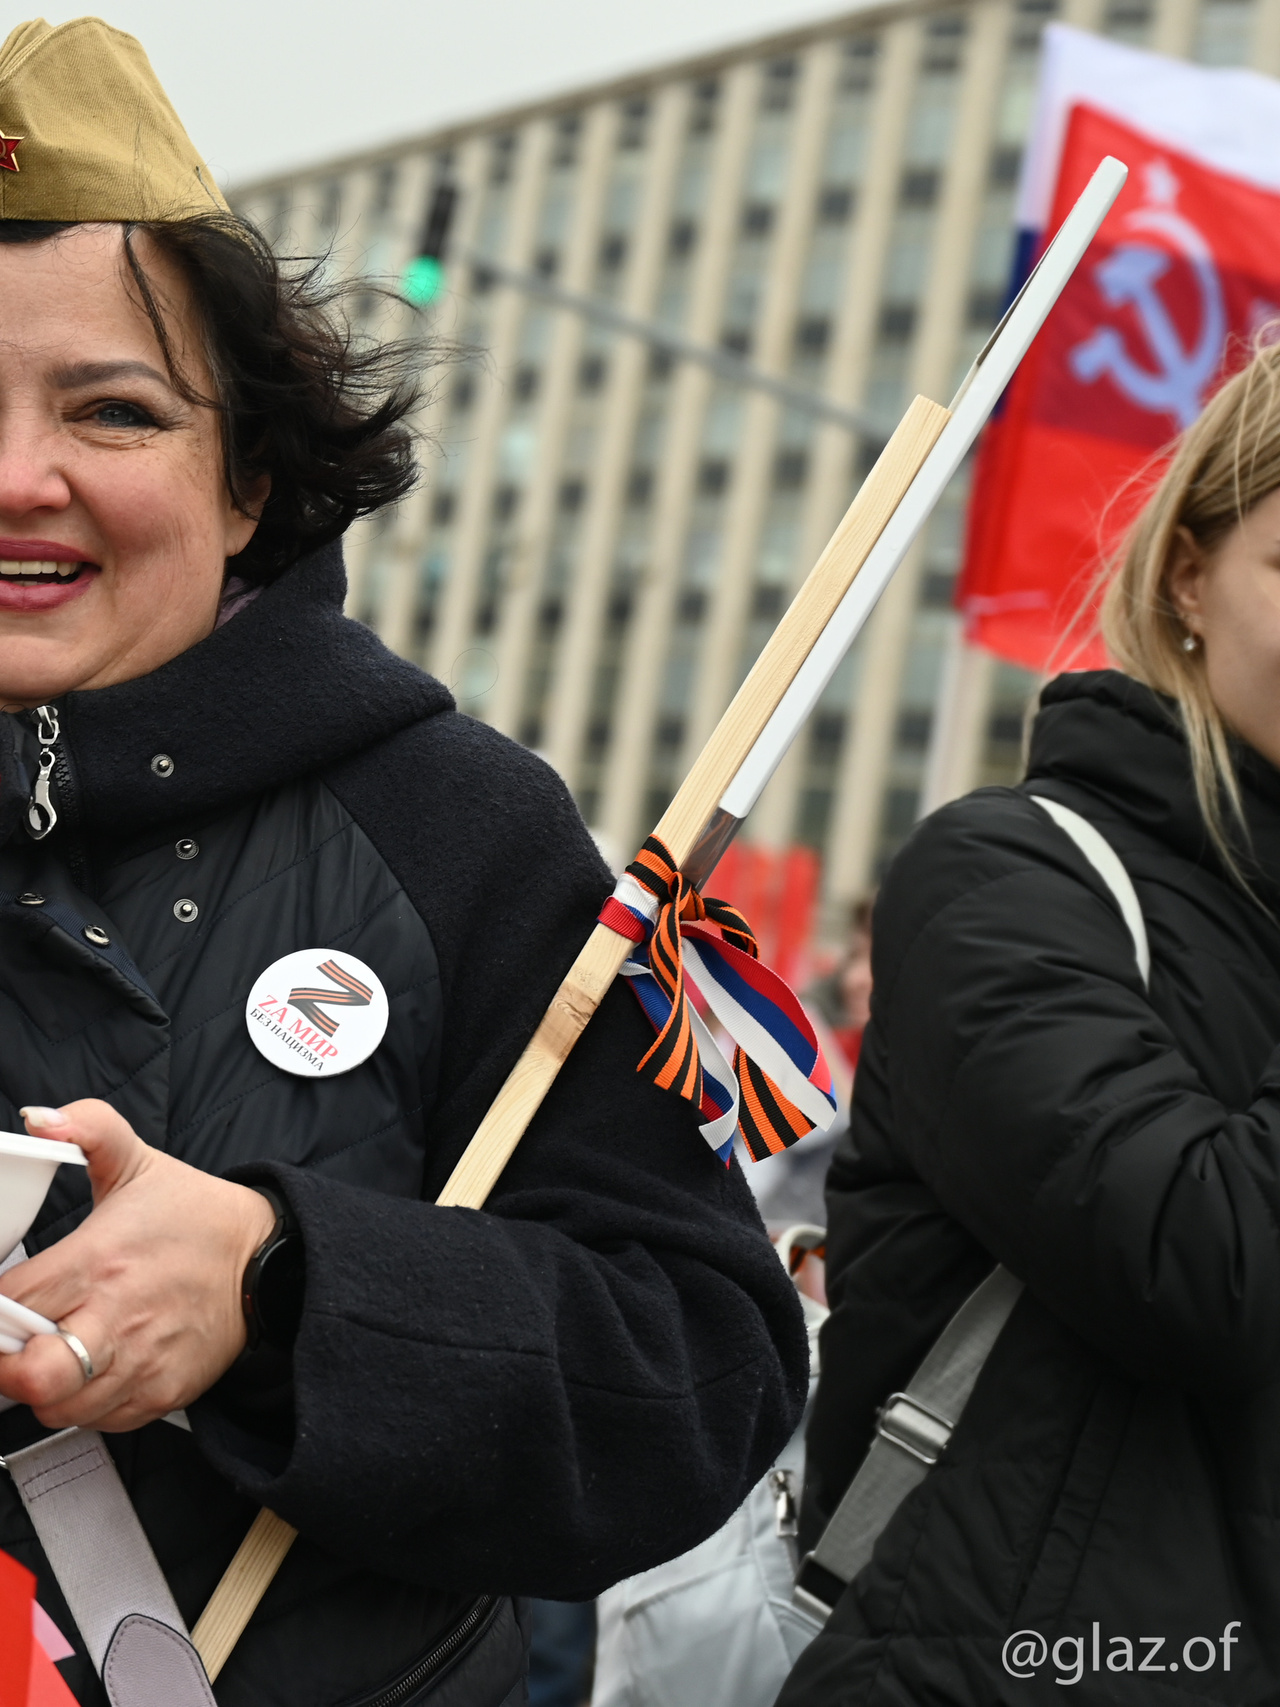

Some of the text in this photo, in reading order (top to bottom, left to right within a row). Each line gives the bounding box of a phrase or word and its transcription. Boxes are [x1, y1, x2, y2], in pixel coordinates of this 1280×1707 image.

[249, 1008, 325, 1071] БЕЗ НАЦИЗМА
[287, 1017, 339, 1060] МИР
